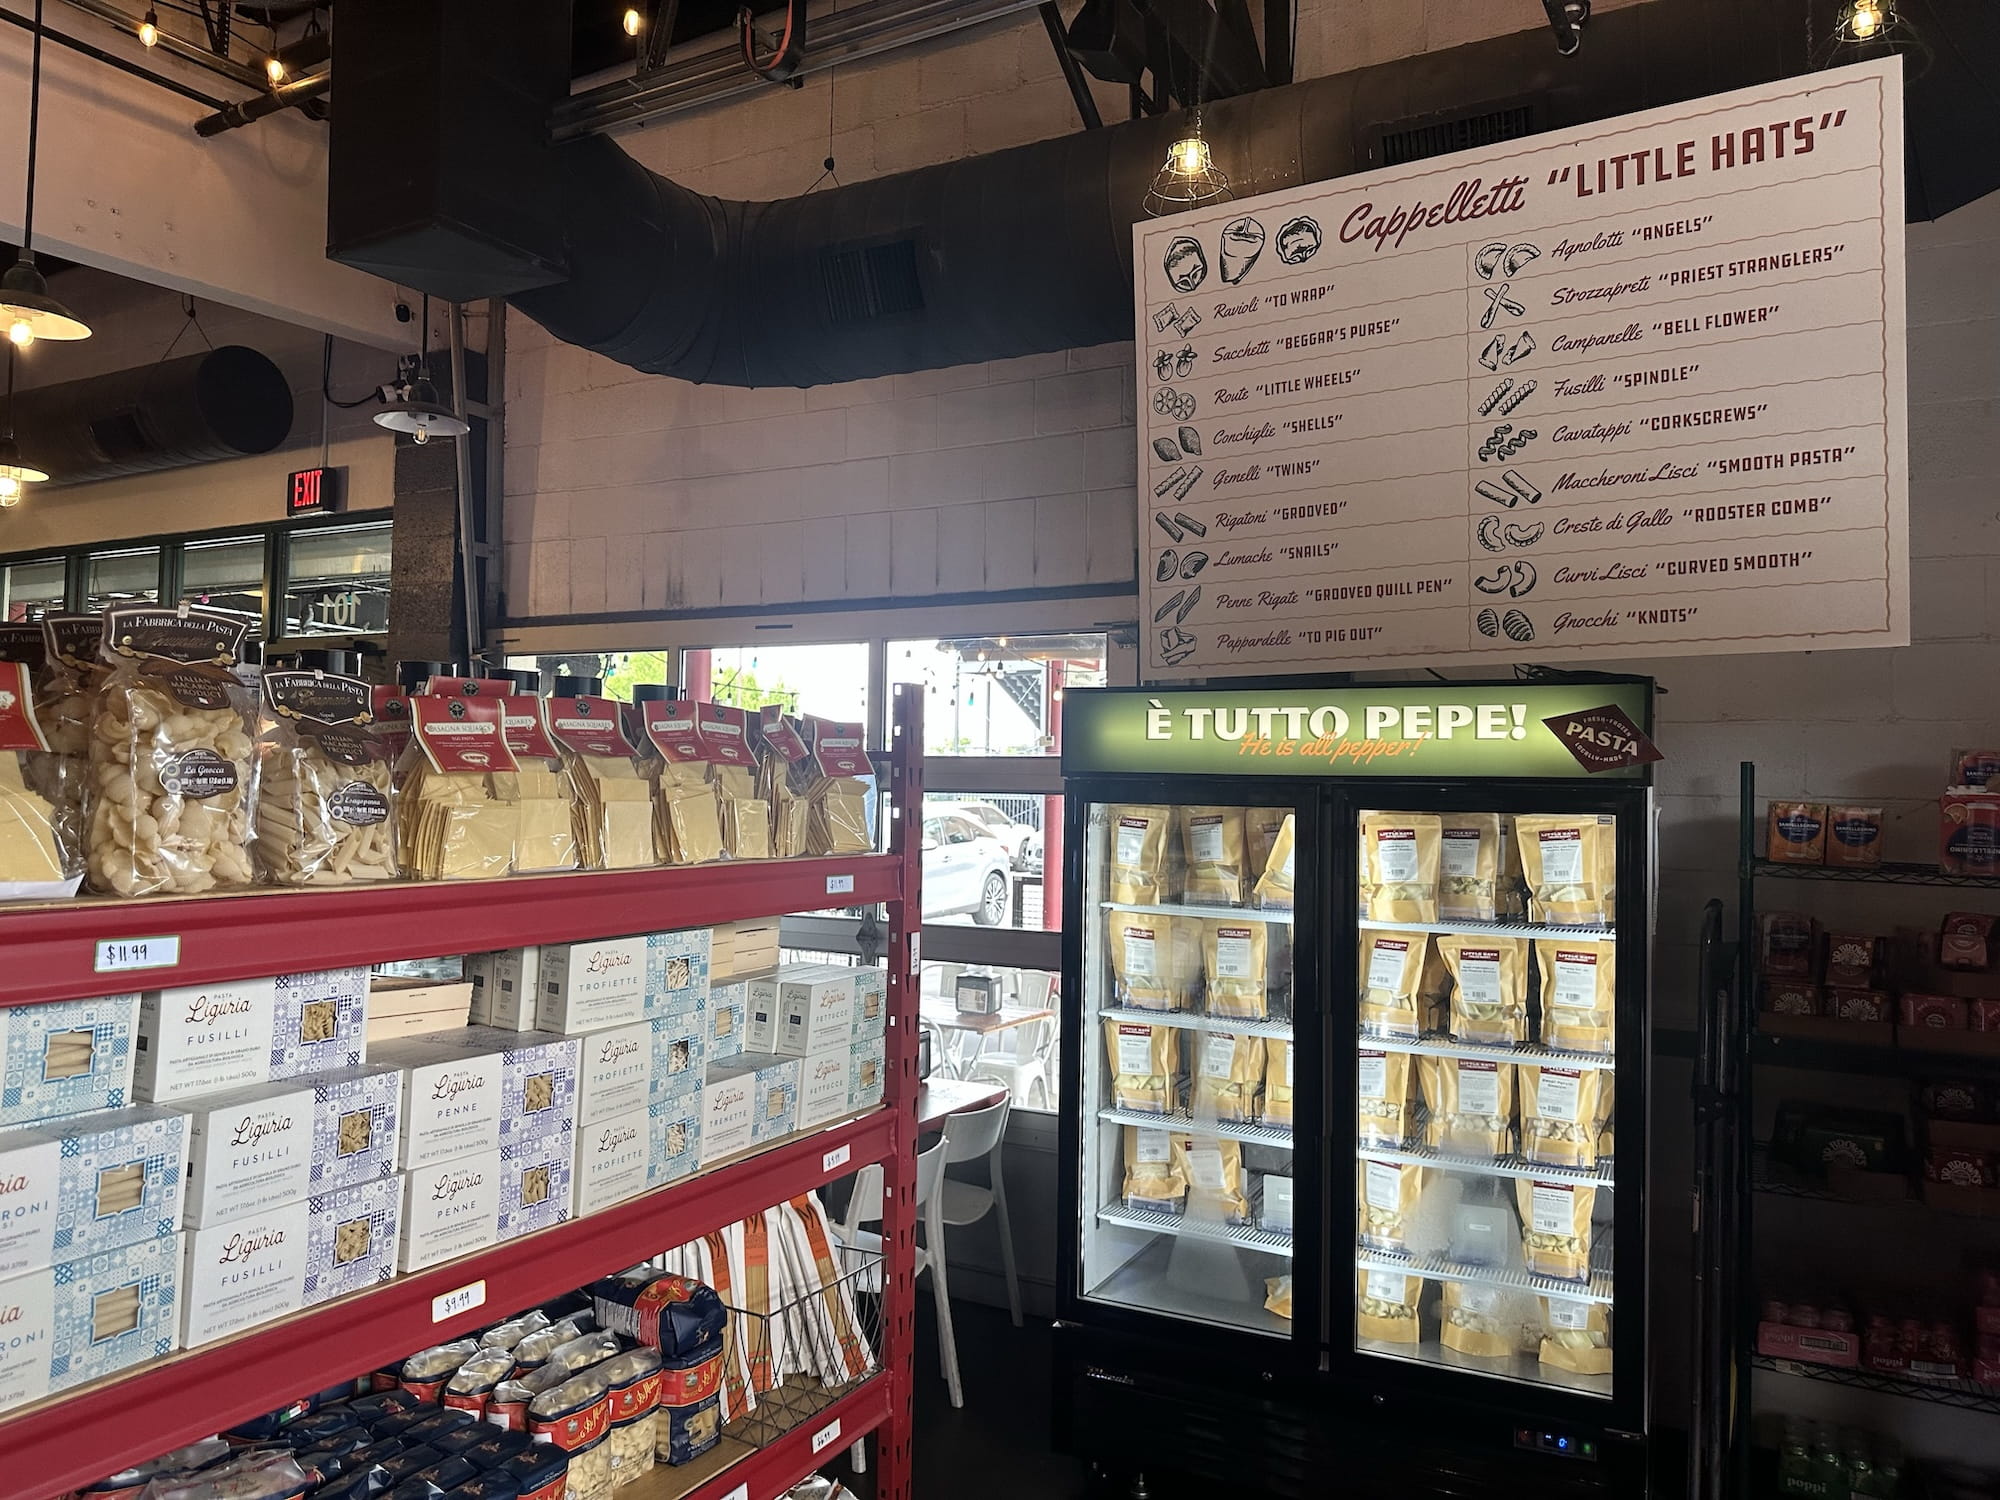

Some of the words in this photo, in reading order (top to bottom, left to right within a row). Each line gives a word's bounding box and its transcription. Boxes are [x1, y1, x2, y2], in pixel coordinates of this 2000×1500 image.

[1339, 175, 1529, 253] Cappelletti
[1551, 231, 1625, 260] Agnolotti
[1550, 276, 1651, 306] Strozzapreti
[1213, 297, 1259, 320] Ravioli
[1551, 324, 1644, 354] Campanelle
[1212, 341, 1270, 363] Sacchetti
[1214, 387, 1249, 405] Route
[1553, 377, 1605, 398] Fusilli
[1212, 425, 1276, 447] Conchiglie
[1551, 420, 1632, 444] Cavatappi
[294, 470, 322, 506] EXIT
[1212, 465, 1260, 490] Gemelli
[1551, 467, 1649, 493] Maccheroni
[1648, 463, 1700, 482] Lisci
[1215, 510, 1268, 532] Rigatoni
[1553, 517, 1602, 535] Creste
[1607, 512, 1623, 530] di
[1626, 507, 1673, 533] Gallo
[1213, 549, 1273, 567] Lumache
[1553, 565, 1600, 584] Curvi
[1599, 563, 1648, 581] Lisci
[1216, 594, 1253, 610] Penne
[1258, 591, 1298, 611] Rigate
[1376, 582, 1413, 597] QUILL
[135, 616, 182, 627] FABBRICA
[207, 622, 233, 636] PASTA
[1553, 609, 1619, 630] Gnocchi
[1216, 632, 1292, 651] Pappardelle
[1325, 630, 1346, 642] PIG
[172, 681, 222, 692] MACARONI
[175, 676, 209, 684] ITALIAN
[284, 678, 322, 688] FABBRICA
[342, 683, 364, 697] PASTA
[177, 688, 221, 698] PRODUCT
[1147, 699, 1172, 740] È
[1181, 705, 1349, 740] TUTTO
[1364, 704, 1527, 740] PEPE!
[322, 740, 362, 749] MACARONI
[1238, 731, 1272, 757] He
[1277, 734, 1295, 757] is
[1301, 730, 1334, 758] all
[1329, 730, 1427, 764] pepper!
[1566, 721, 1638, 756] PASTA
[327, 747, 363, 755] PRODUCT
[184, 766, 195, 774] La
[106, 944, 147, 965] $11.99
[587, 951, 631, 975] Liguria
[579, 977, 637, 992] TROFIETTE
[185, 995, 252, 1025] Liguria
[819, 990, 847, 1009] Liguria
[815, 1010, 849, 1023] FETTUCCE
[187, 1029, 248, 1046] FUSILLI
[599, 1039, 639, 1064] Liguria
[593, 1063, 644, 1082] TROFIETTE
[814, 1062, 841, 1080] Liguria
[170, 1083, 182, 1091] NET
[432, 1074, 485, 1101] Liguria
[810, 1080, 843, 1095] FETTUCCE
[437, 1103, 477, 1118] PENNE
[713, 1089, 744, 1112] Liguria
[258, 1111, 275, 1119] PASTA
[231, 1116, 293, 1147] Liguria
[598, 1128, 637, 1153] Liguria
[233, 1147, 290, 1168] FUSILLI
[591, 1149, 643, 1173] TROFIETTE
[432, 1172, 483, 1200] Liguria
[216, 1208, 228, 1216] NET
[230, 1206, 241, 1215] WT
[437, 1201, 476, 1218] PENNE
[249, 1226, 267, 1234] PASTA
[219, 1229, 286, 1264] Liguria
[222, 1260, 282, 1286] FUSILLI
[444, 1291, 470, 1313] $9.99
[204, 1326, 215, 1335] NET
[1787, 1477, 1827, 1493] poppi
